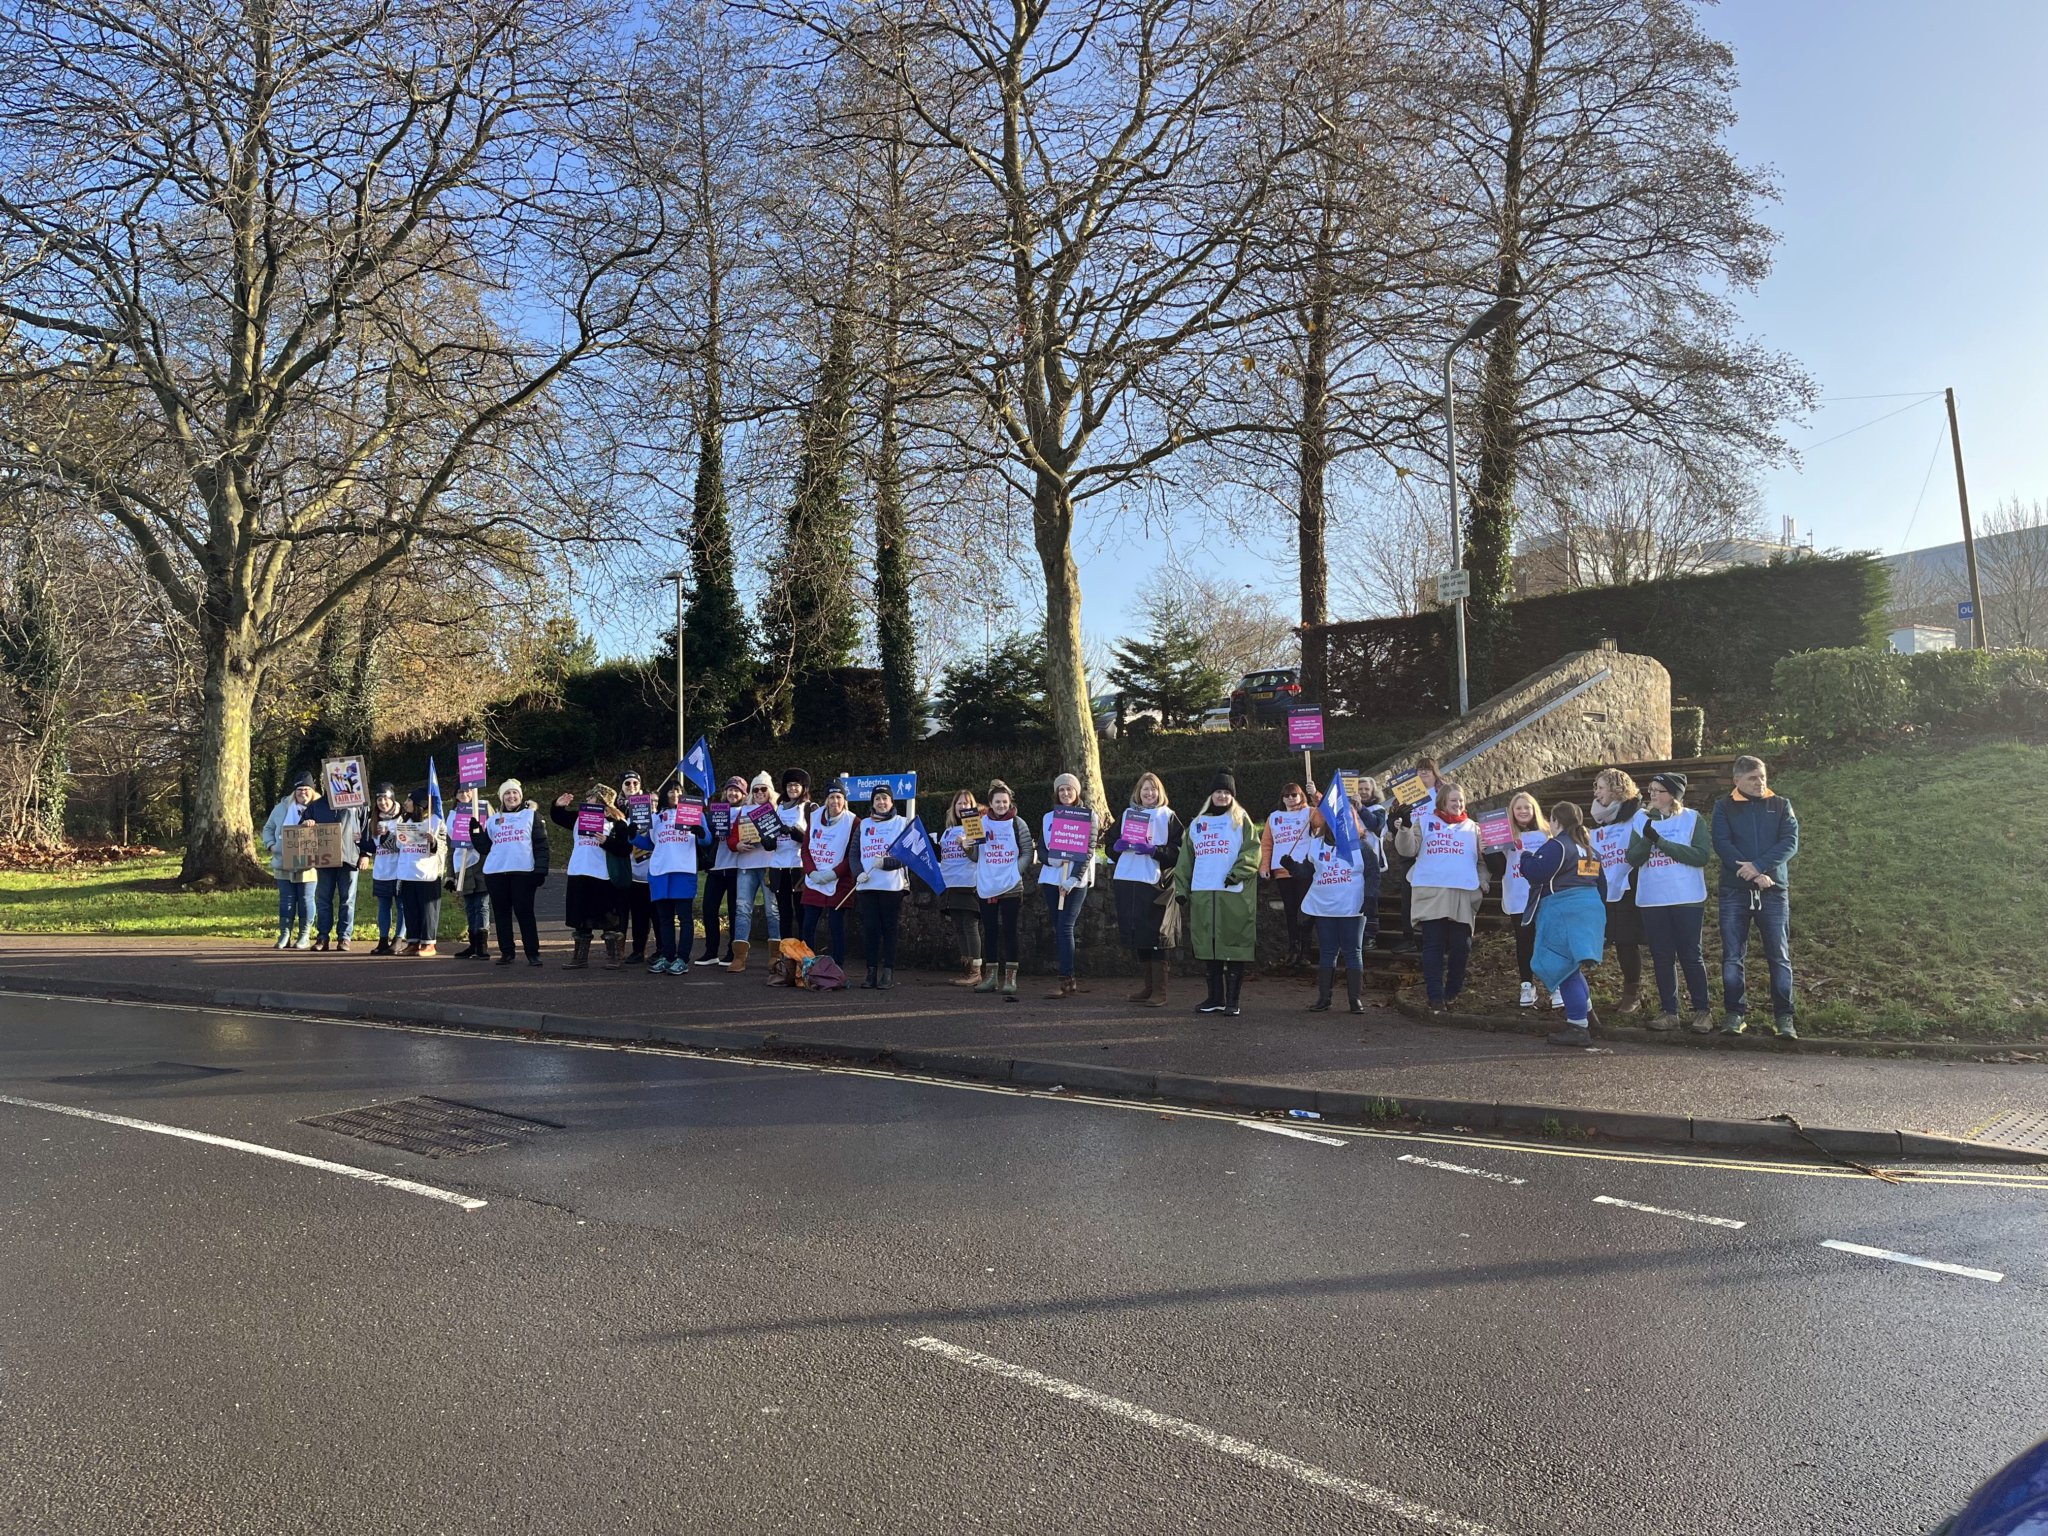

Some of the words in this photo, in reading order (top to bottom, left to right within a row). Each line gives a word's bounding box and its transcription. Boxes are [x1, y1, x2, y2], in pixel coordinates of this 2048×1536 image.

[1960, 606, 1974, 614] OU
[858, 778, 890, 788] Pedestrian
[859, 790, 872, 798] entr
[336, 795, 350, 804] FAIR
[350, 794, 362, 802] PAY
[752, 804, 770, 818] HONK
[286, 830, 304, 838] THE
[309, 827, 338, 837] PUBLIC
[1055, 831, 1086, 839] shortages
[287, 840, 332, 849] SUPPORT
[1195, 841, 1216, 849] VOICE
[1601, 842, 1616, 852] THE
[1196, 848, 1229, 857] NURSING
[292, 854, 332, 866] NHS
[1648, 859, 1679, 868] URSIN
[1318, 876, 1351, 885] NURSING
